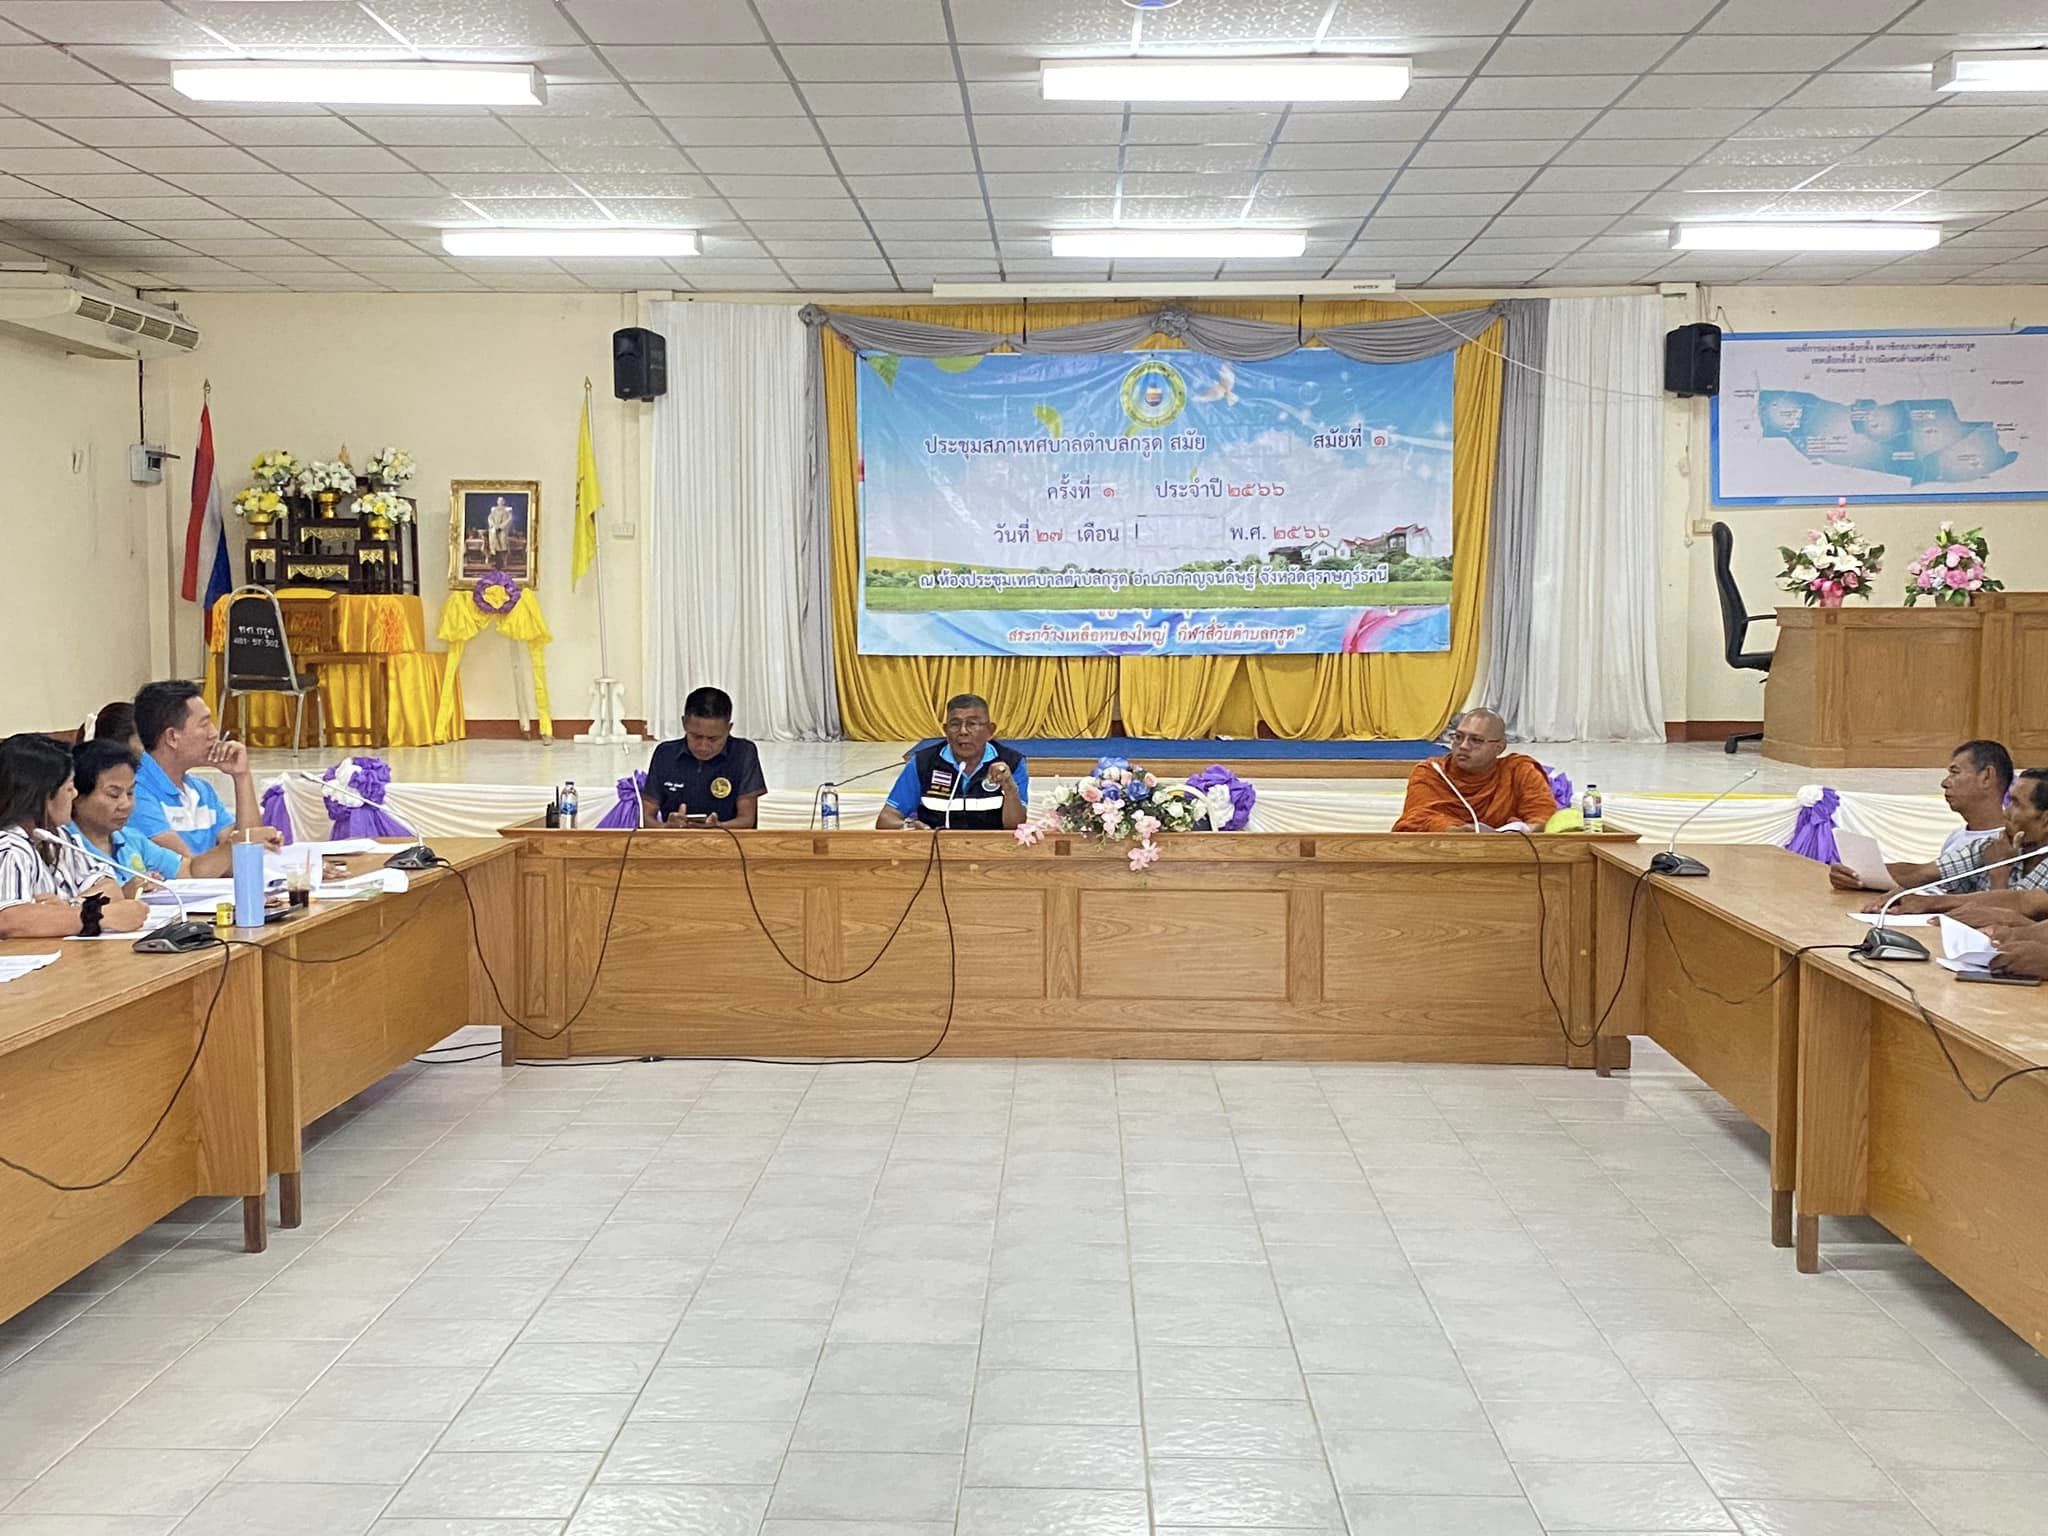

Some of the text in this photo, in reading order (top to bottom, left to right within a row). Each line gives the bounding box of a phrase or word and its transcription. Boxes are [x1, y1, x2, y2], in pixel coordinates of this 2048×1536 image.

[924, 423, 1387, 460] ประชุมสภาเทศบาลตำบลกรูด สมัย สมัยที่ ๑
[1047, 472, 1286, 500] ครั้งที่ ๑ ประจำปี ๒๕๖๖
[993, 517, 1030, 544] วันที่
[1077, 521, 1121, 544] เดือน
[1230, 525, 1267, 542] พ.ศ.
[1272, 524, 1331, 541] ๒๕๖๖
[920, 573, 935, 588] ณ
